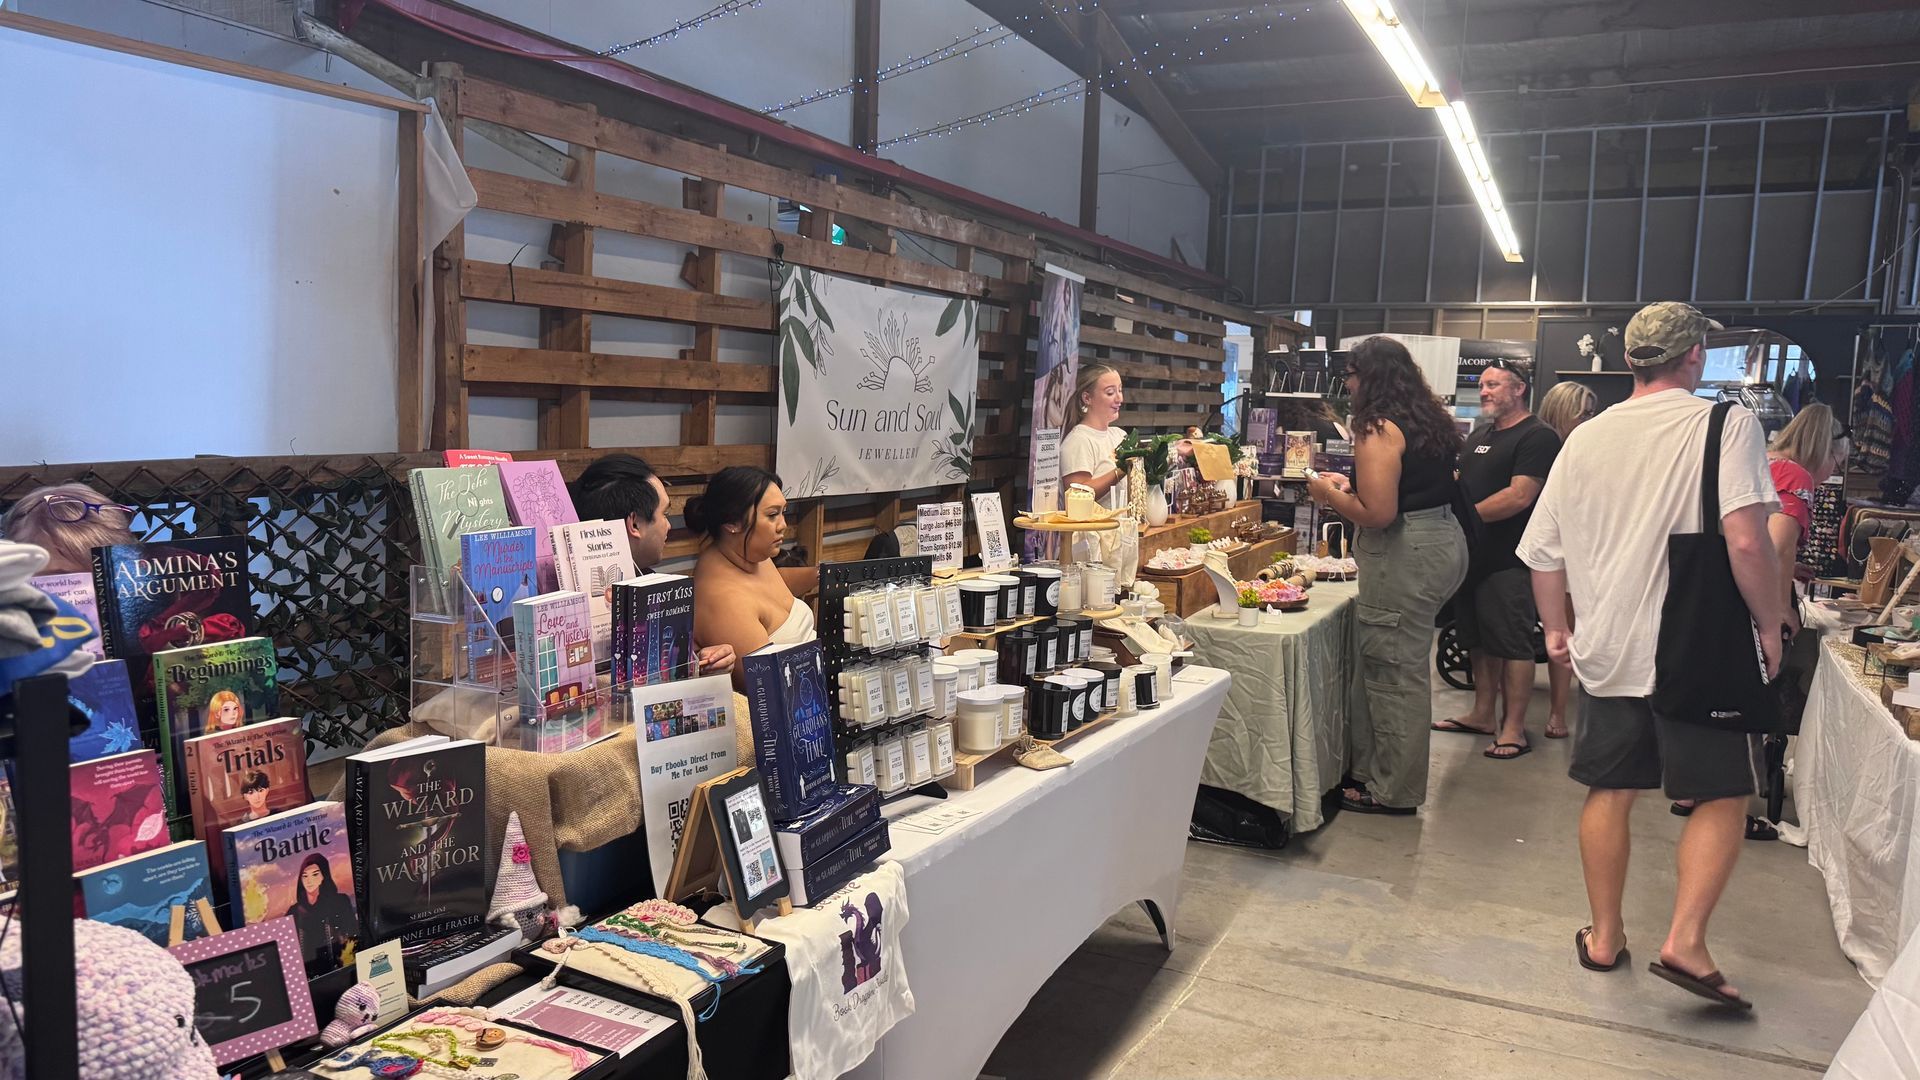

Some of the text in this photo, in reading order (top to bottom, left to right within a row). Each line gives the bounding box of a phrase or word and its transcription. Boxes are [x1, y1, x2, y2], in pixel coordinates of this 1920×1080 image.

[827, 400, 943, 432] Sun and Soul
[435, 480, 455, 505] The
[441, 509, 502, 533] Mystery
[921, 521, 944, 531] Large Jars
[490, 529, 532, 540] WILLIAMSON
[580, 528, 612, 539] First Kiss
[920, 534, 942, 542] Diffusers
[484, 541, 524, 556] Murder
[587, 542, 613, 552] Stories
[934, 544, 947, 552] Sprays
[946, 552, 952, 561] $6
[114, 550, 239, 580] ADMINA'S
[116, 572, 240, 601] ARGUMENT
[647, 586, 693, 605] FIRST KISS
[537, 596, 585, 613] LEE WILLIAMSON
[646, 604, 690, 621] SWEET ROMANCE
[537, 613, 579, 636] Love and
[549, 628, 589, 648] Mystery
[167, 655, 273, 684] Beginnings
[756, 687, 770, 734] GUARDIANS
[764, 730, 778, 767] TIME
[792, 712, 828, 740] GUARDIANS
[213, 742, 224, 750] The
[253, 731, 264, 740] The
[799, 736, 828, 763] TIME
[217, 740, 285, 774] Trials
[651, 750, 727, 775] Buy Ebooks Direct From
[187, 746, 198, 797] 2 Trials
[671, 764, 708, 780] Me For Less
[417, 779, 442, 794] THE
[355, 776, 363, 826] WIZARD
[382, 787, 474, 820] WIZARD
[252, 829, 264, 838] The
[294, 818, 304, 826] The
[305, 812, 329, 823] Warrior
[841, 814, 856, 830] TIME
[254, 823, 333, 863] Battle
[400, 836, 456, 859] AND THE
[847, 846, 865, 862] TIME
[376, 845, 480, 884] WARRIOR
[409, 906, 447, 921] SERIES ONE
[427, 914, 481, 937] LEE FRASER
[507, 1005, 524, 1016] Price
[524, 999, 536, 1009] List
